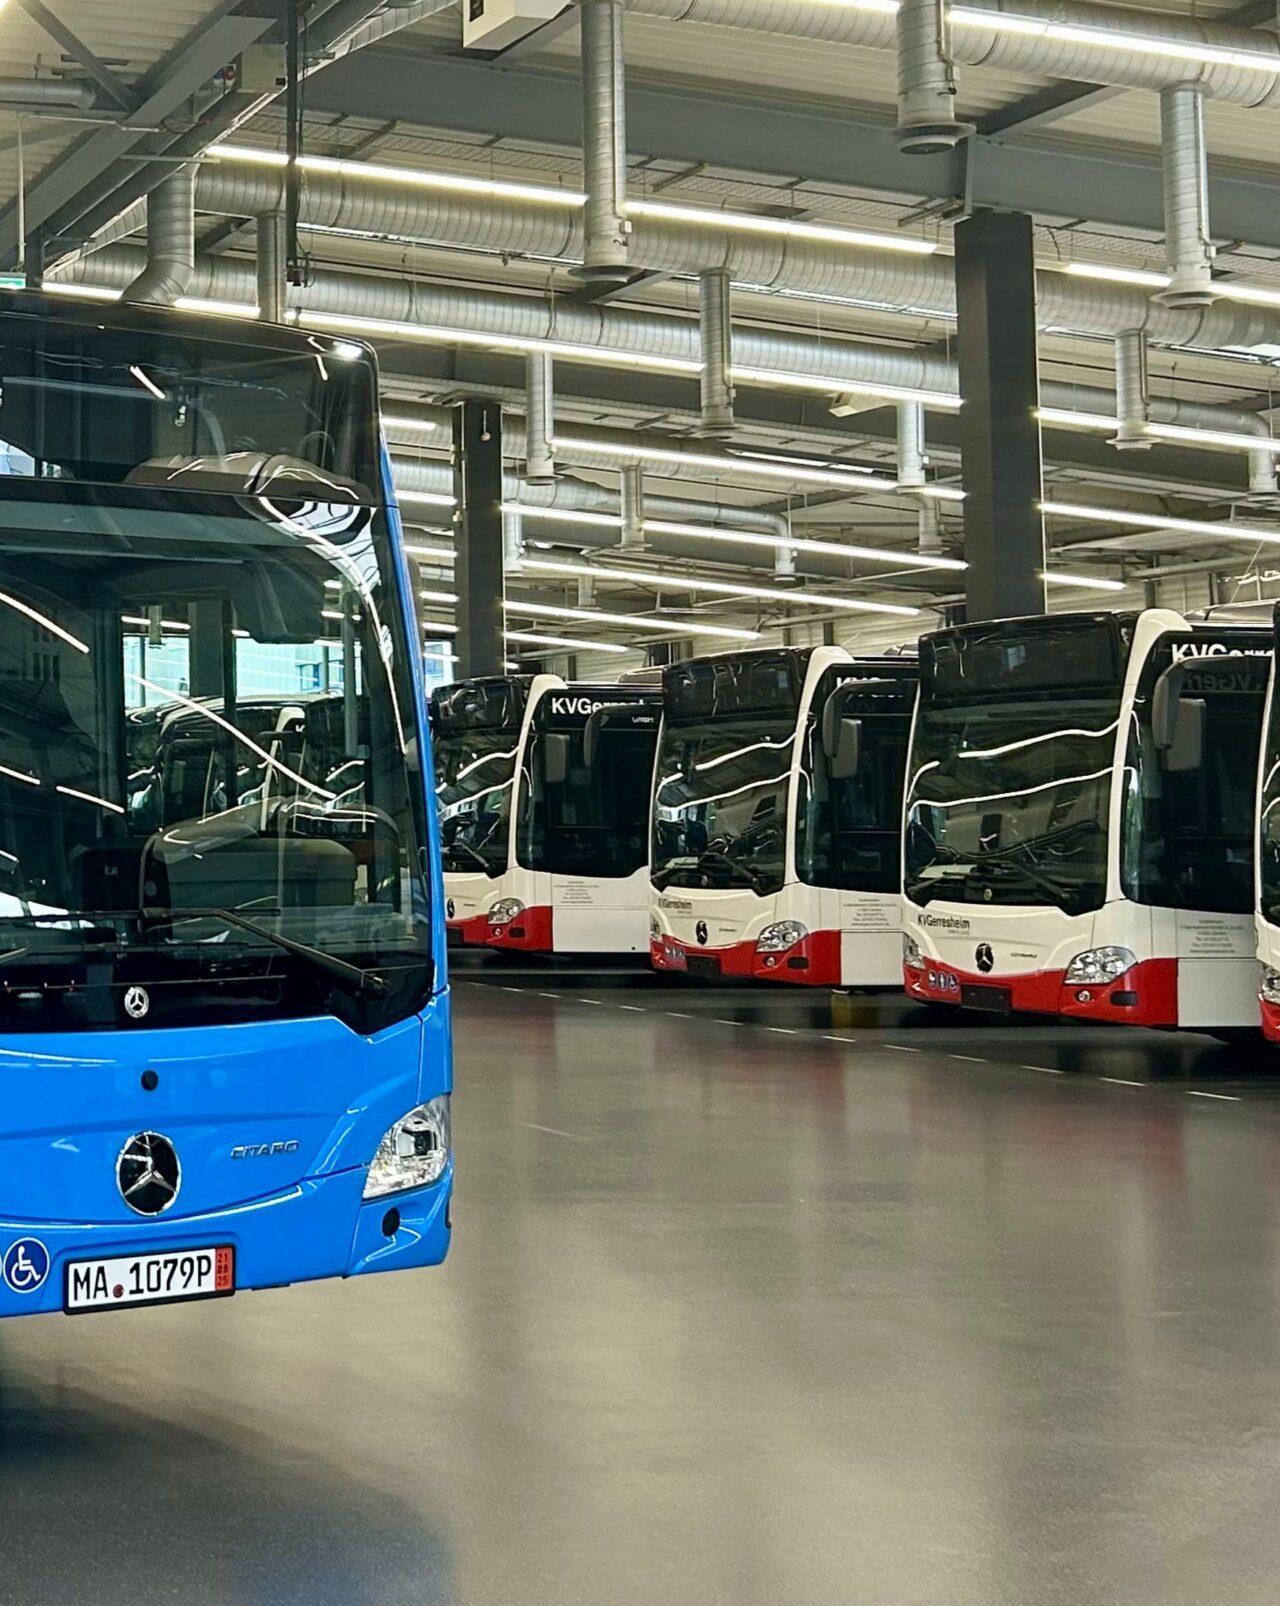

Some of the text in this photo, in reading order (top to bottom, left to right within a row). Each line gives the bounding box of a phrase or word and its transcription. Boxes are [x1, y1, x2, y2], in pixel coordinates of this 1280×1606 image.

[917, 913, 970, 929] KVGerresheim
[230, 1140, 299, 1158] CITARO
[73, 1254, 212, 1301] MA 1079P
